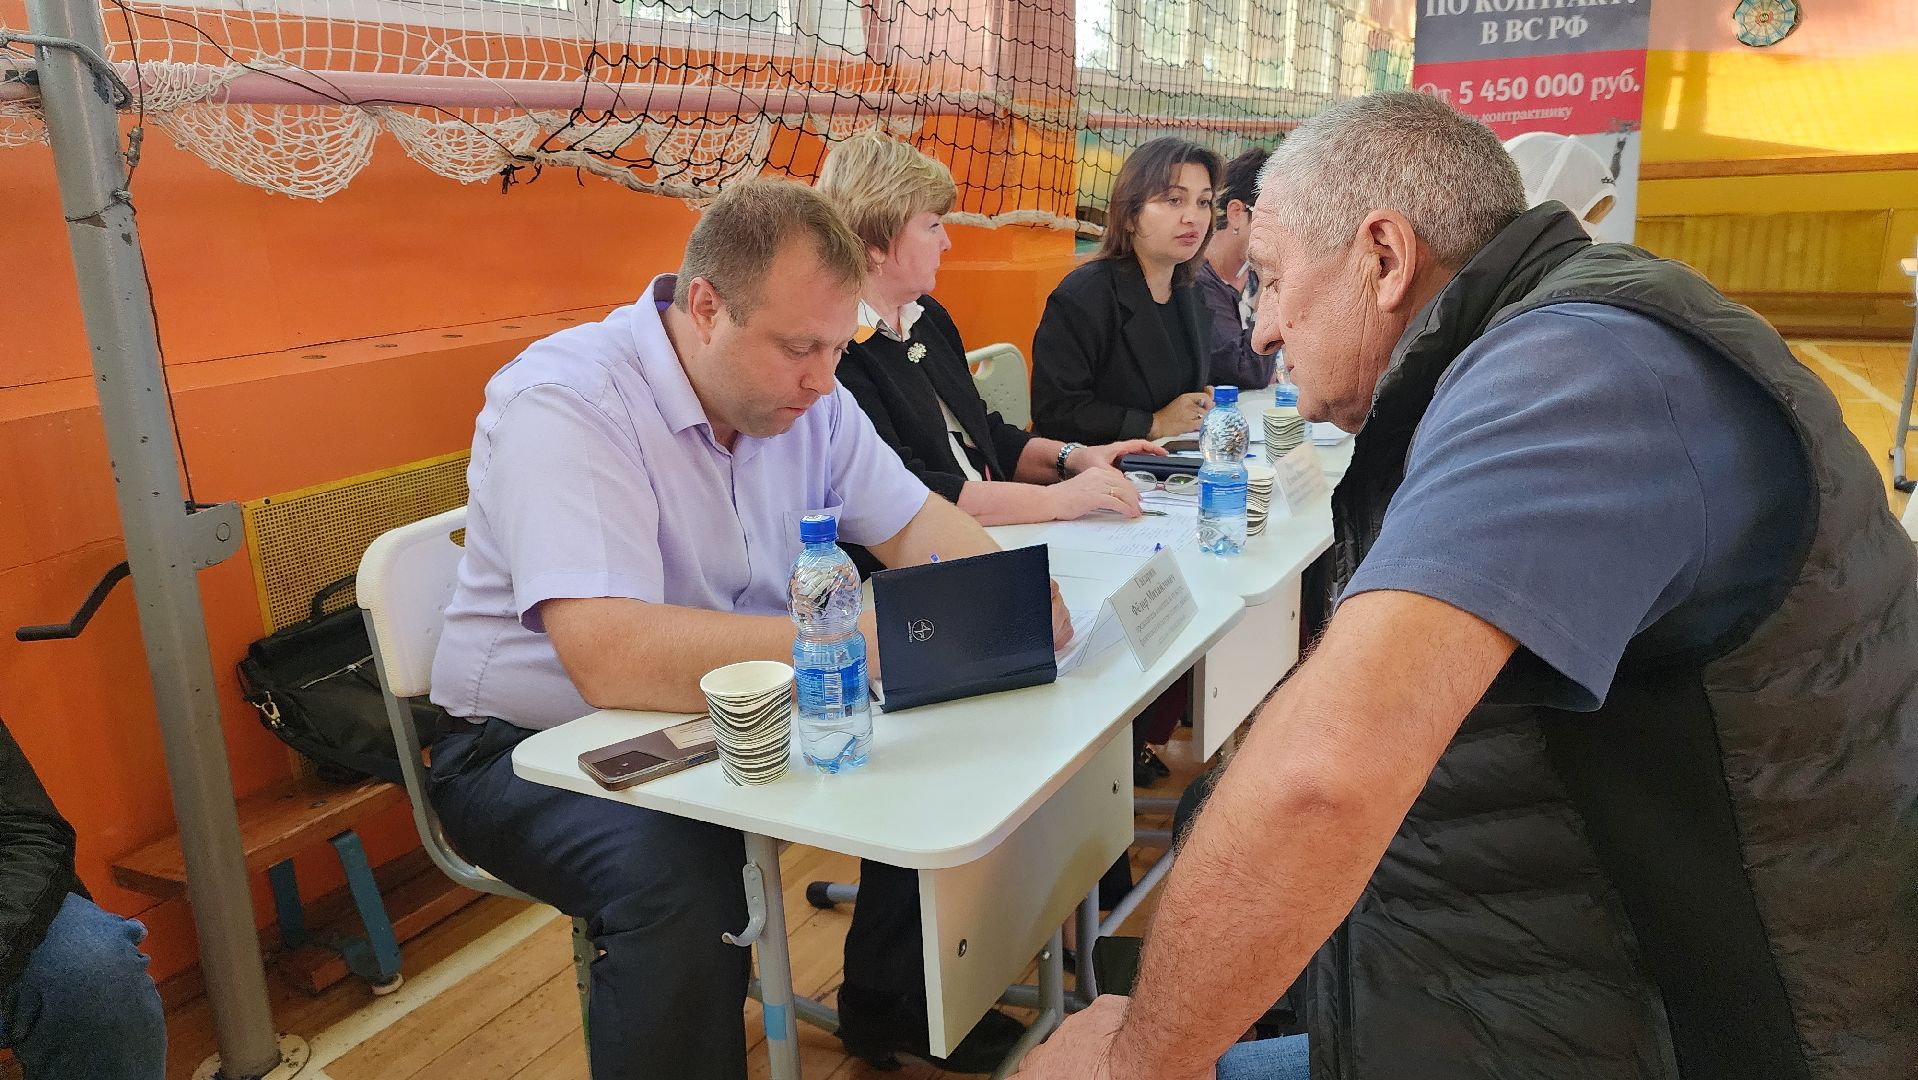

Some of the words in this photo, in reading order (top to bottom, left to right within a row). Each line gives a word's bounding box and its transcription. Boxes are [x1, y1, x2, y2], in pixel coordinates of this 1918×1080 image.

[1480, 20, 1499, 45] В
[1503, 16, 1544, 43] ВС
[1547, 14, 1588, 40] РФ
[1459, 80, 1473, 105] 5
[1480, 76, 1528, 103] 450
[1534, 72, 1585, 99] 000
[1590, 67, 1640, 101] руб.
